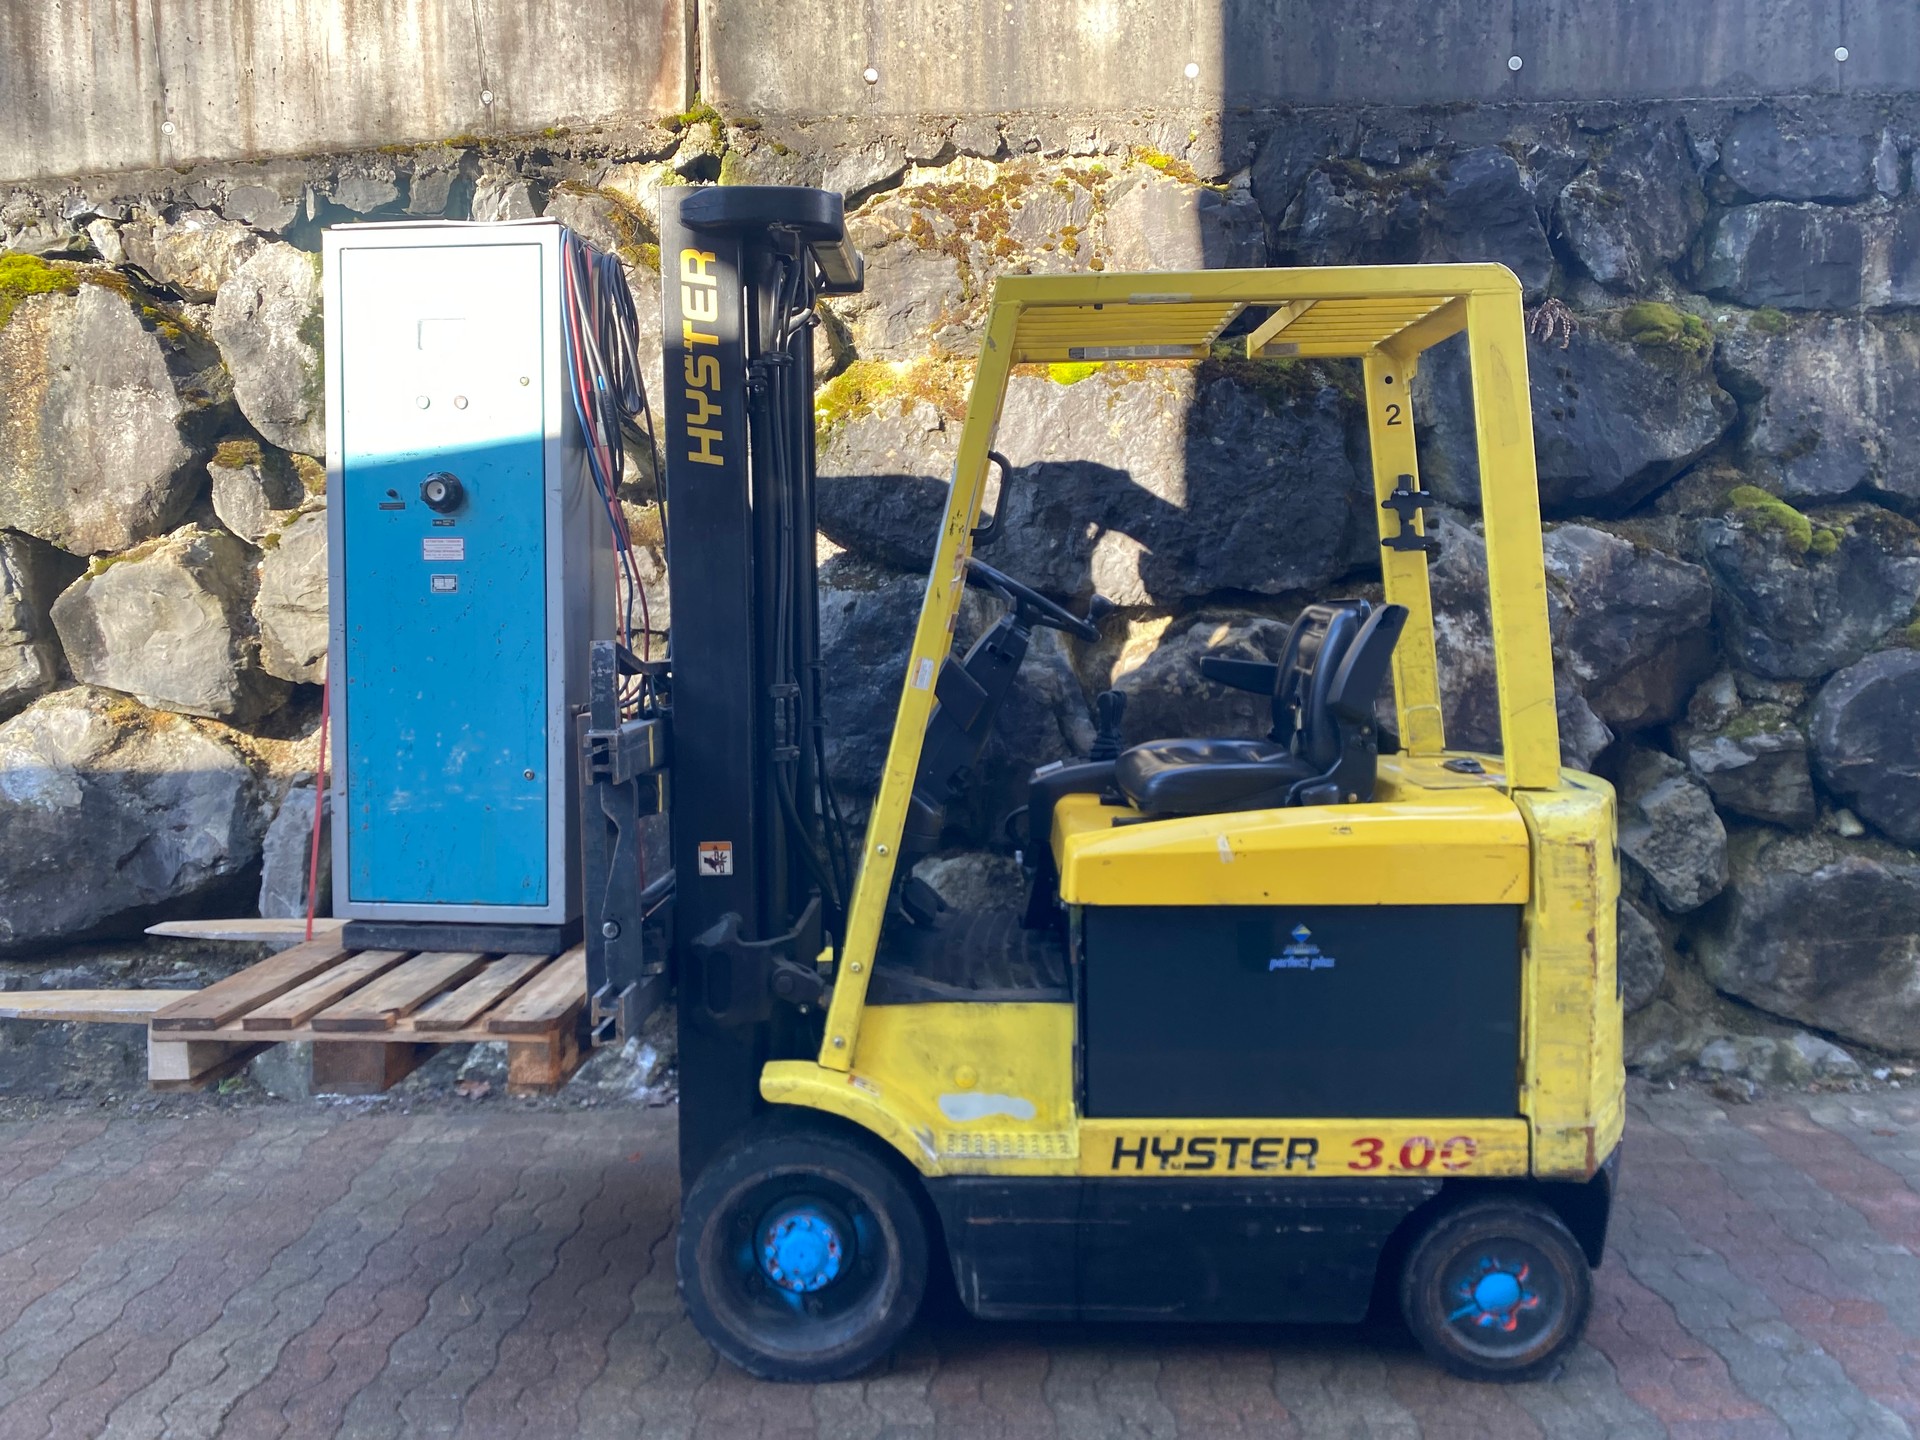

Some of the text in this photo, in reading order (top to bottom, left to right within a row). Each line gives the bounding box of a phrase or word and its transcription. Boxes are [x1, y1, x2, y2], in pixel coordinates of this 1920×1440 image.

[680, 248, 724, 466] HYSTER
[1385, 404, 1402, 426] 2
[1111, 1136, 1477, 1171] HYSTER 3.00
